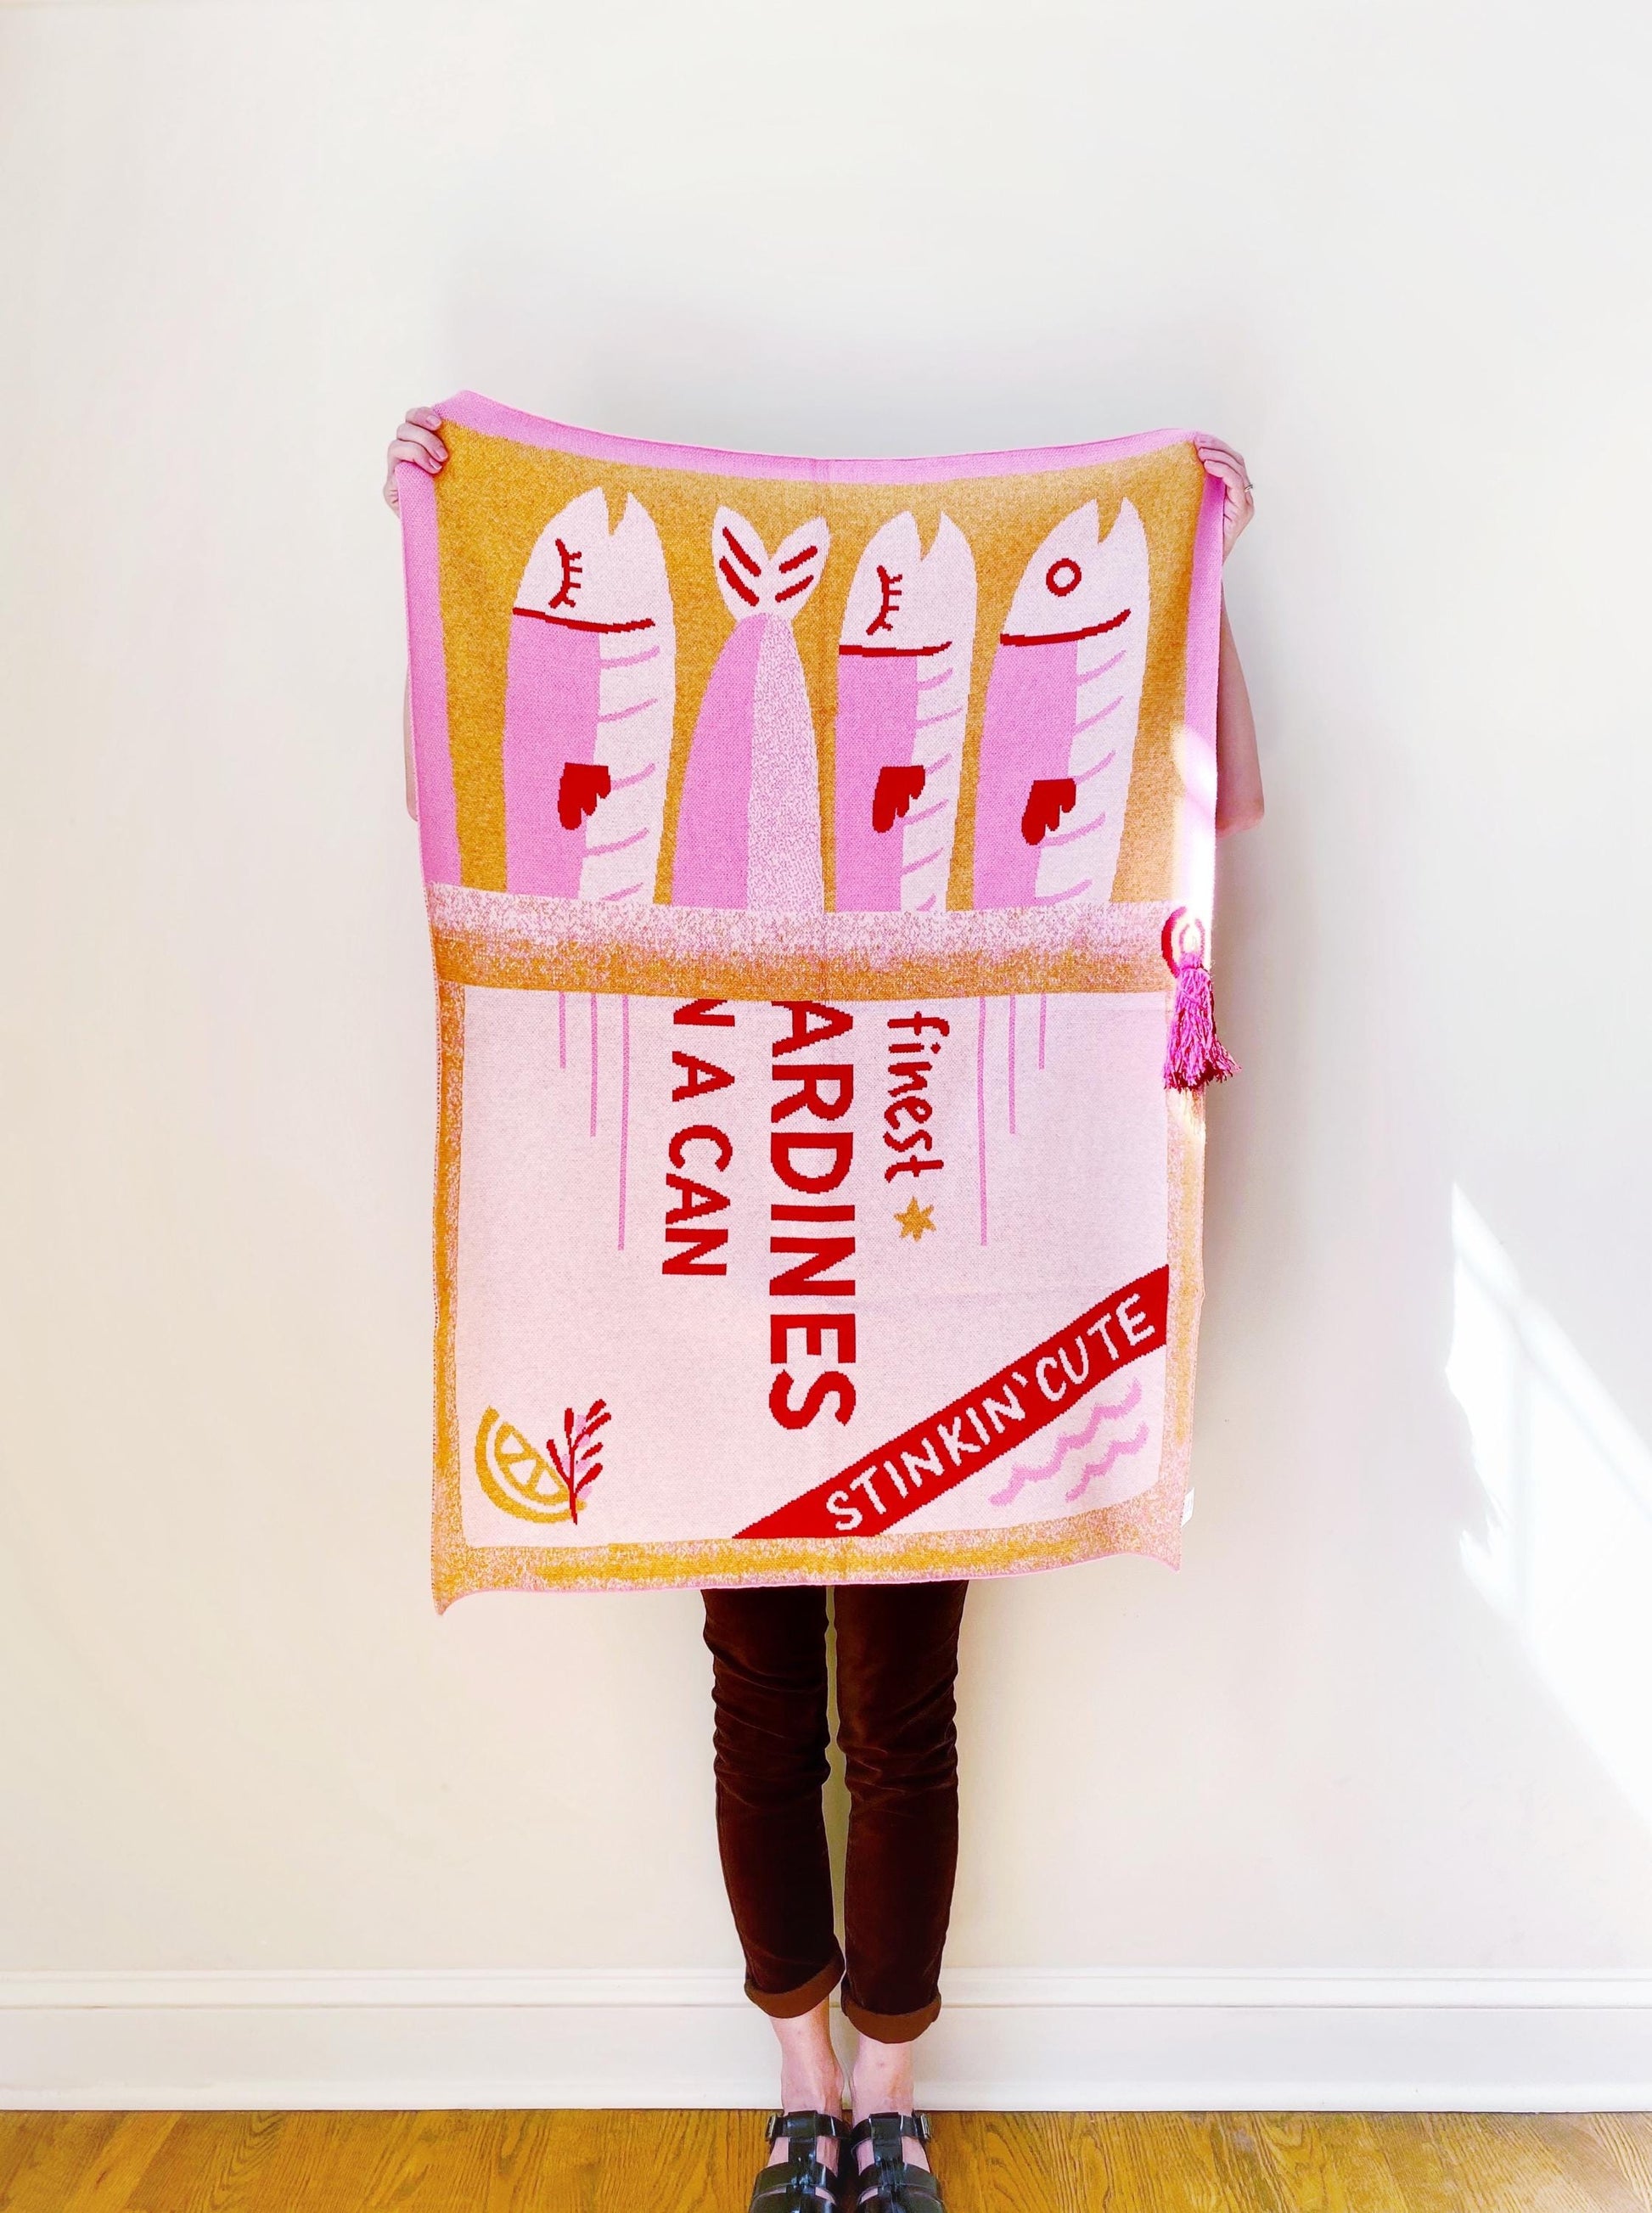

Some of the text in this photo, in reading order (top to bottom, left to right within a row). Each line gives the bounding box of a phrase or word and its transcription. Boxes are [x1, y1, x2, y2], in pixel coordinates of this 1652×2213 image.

[671, 1050, 736, 1103] A
[882, 1011, 950, 1183] finest
[661, 1124, 733, 1276] CAN
[768, 1000, 857, 1430] ARDINES
[825, 1292, 1156, 1531] STINKIN' CUTE
